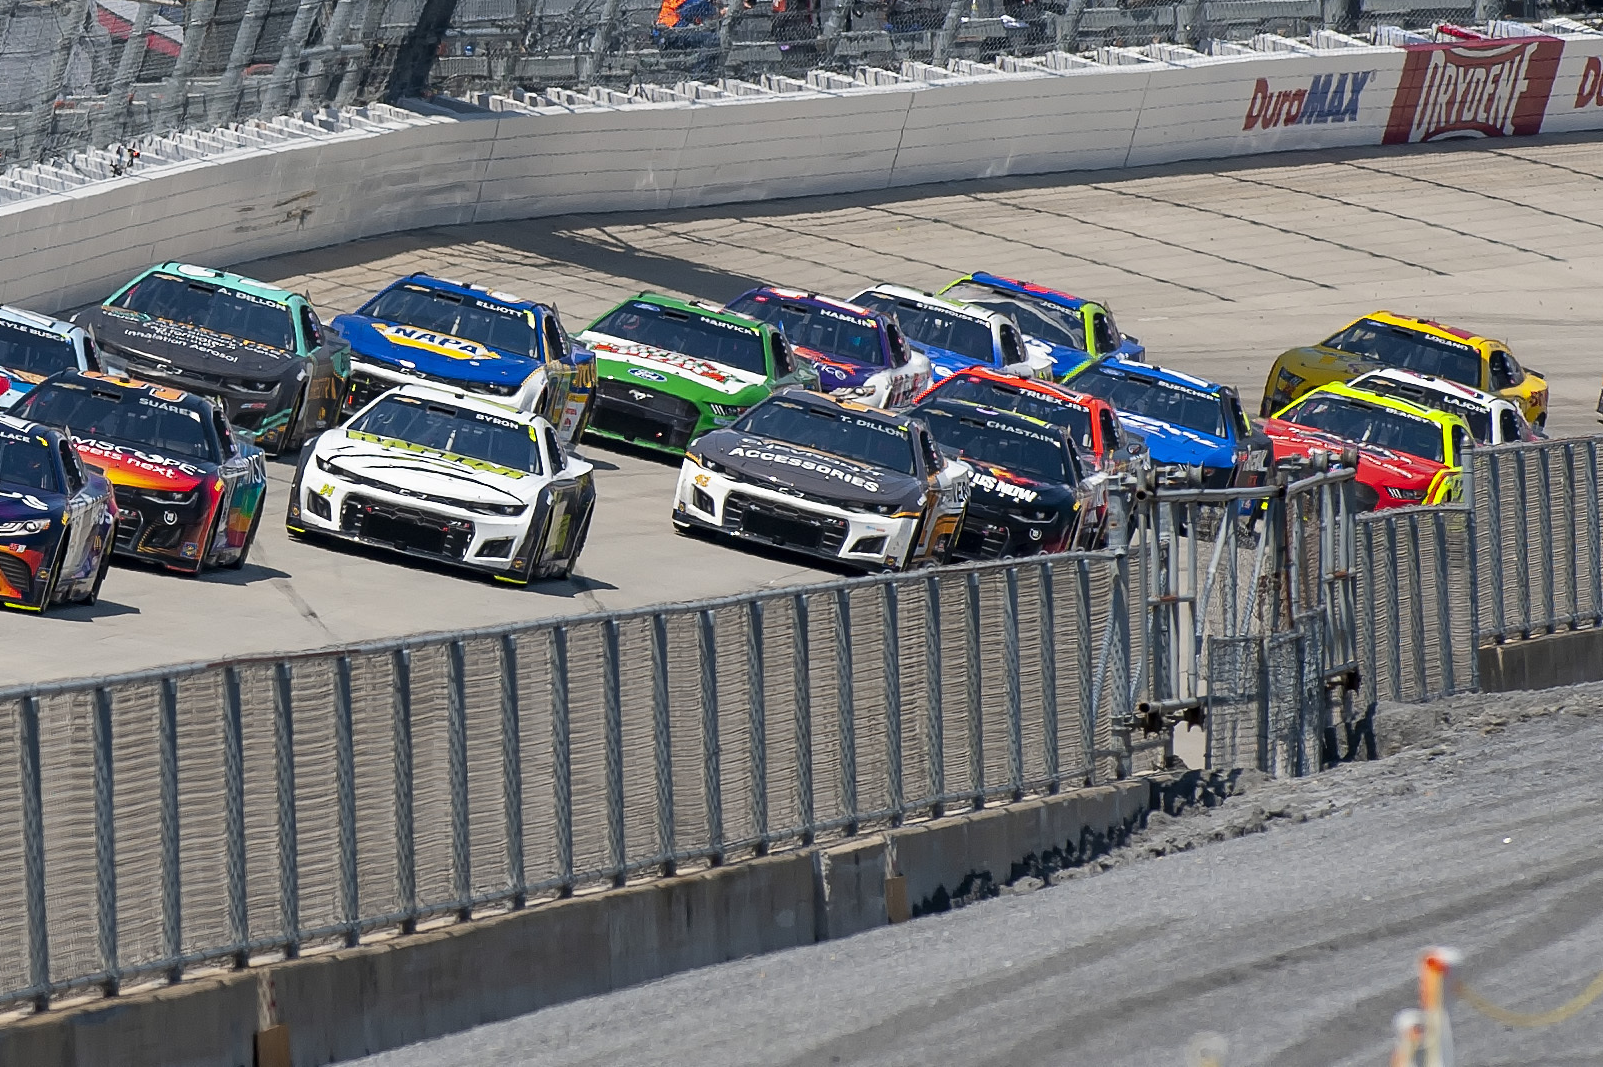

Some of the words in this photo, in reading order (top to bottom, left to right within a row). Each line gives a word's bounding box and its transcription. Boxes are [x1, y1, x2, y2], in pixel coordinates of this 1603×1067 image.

[1242, 70, 1371, 131] DuraMAX
[1411, 42, 1540, 143] DRYDENE
[235, 291, 287, 312] DILLON
[476, 300, 524, 318] ELLIOTT
[821, 308, 872, 328] HAMLIN
[29, 328, 67, 342] BUSCH
[394, 326, 480, 356] NAPA
[1424, 333, 1469, 351] LOGANO
[189, 343, 239, 363] Aerosol
[1018, 388, 1063, 406] TRUEX
[475, 413, 519, 430] BYRON
[856, 419, 906, 438] DILLON
[986, 420, 1055, 444] CHASTAIN
[70, 434, 195, 476] MSCOPE
[126, 457, 176, 479] next
[728, 446, 880, 493] ACCESSORIES
